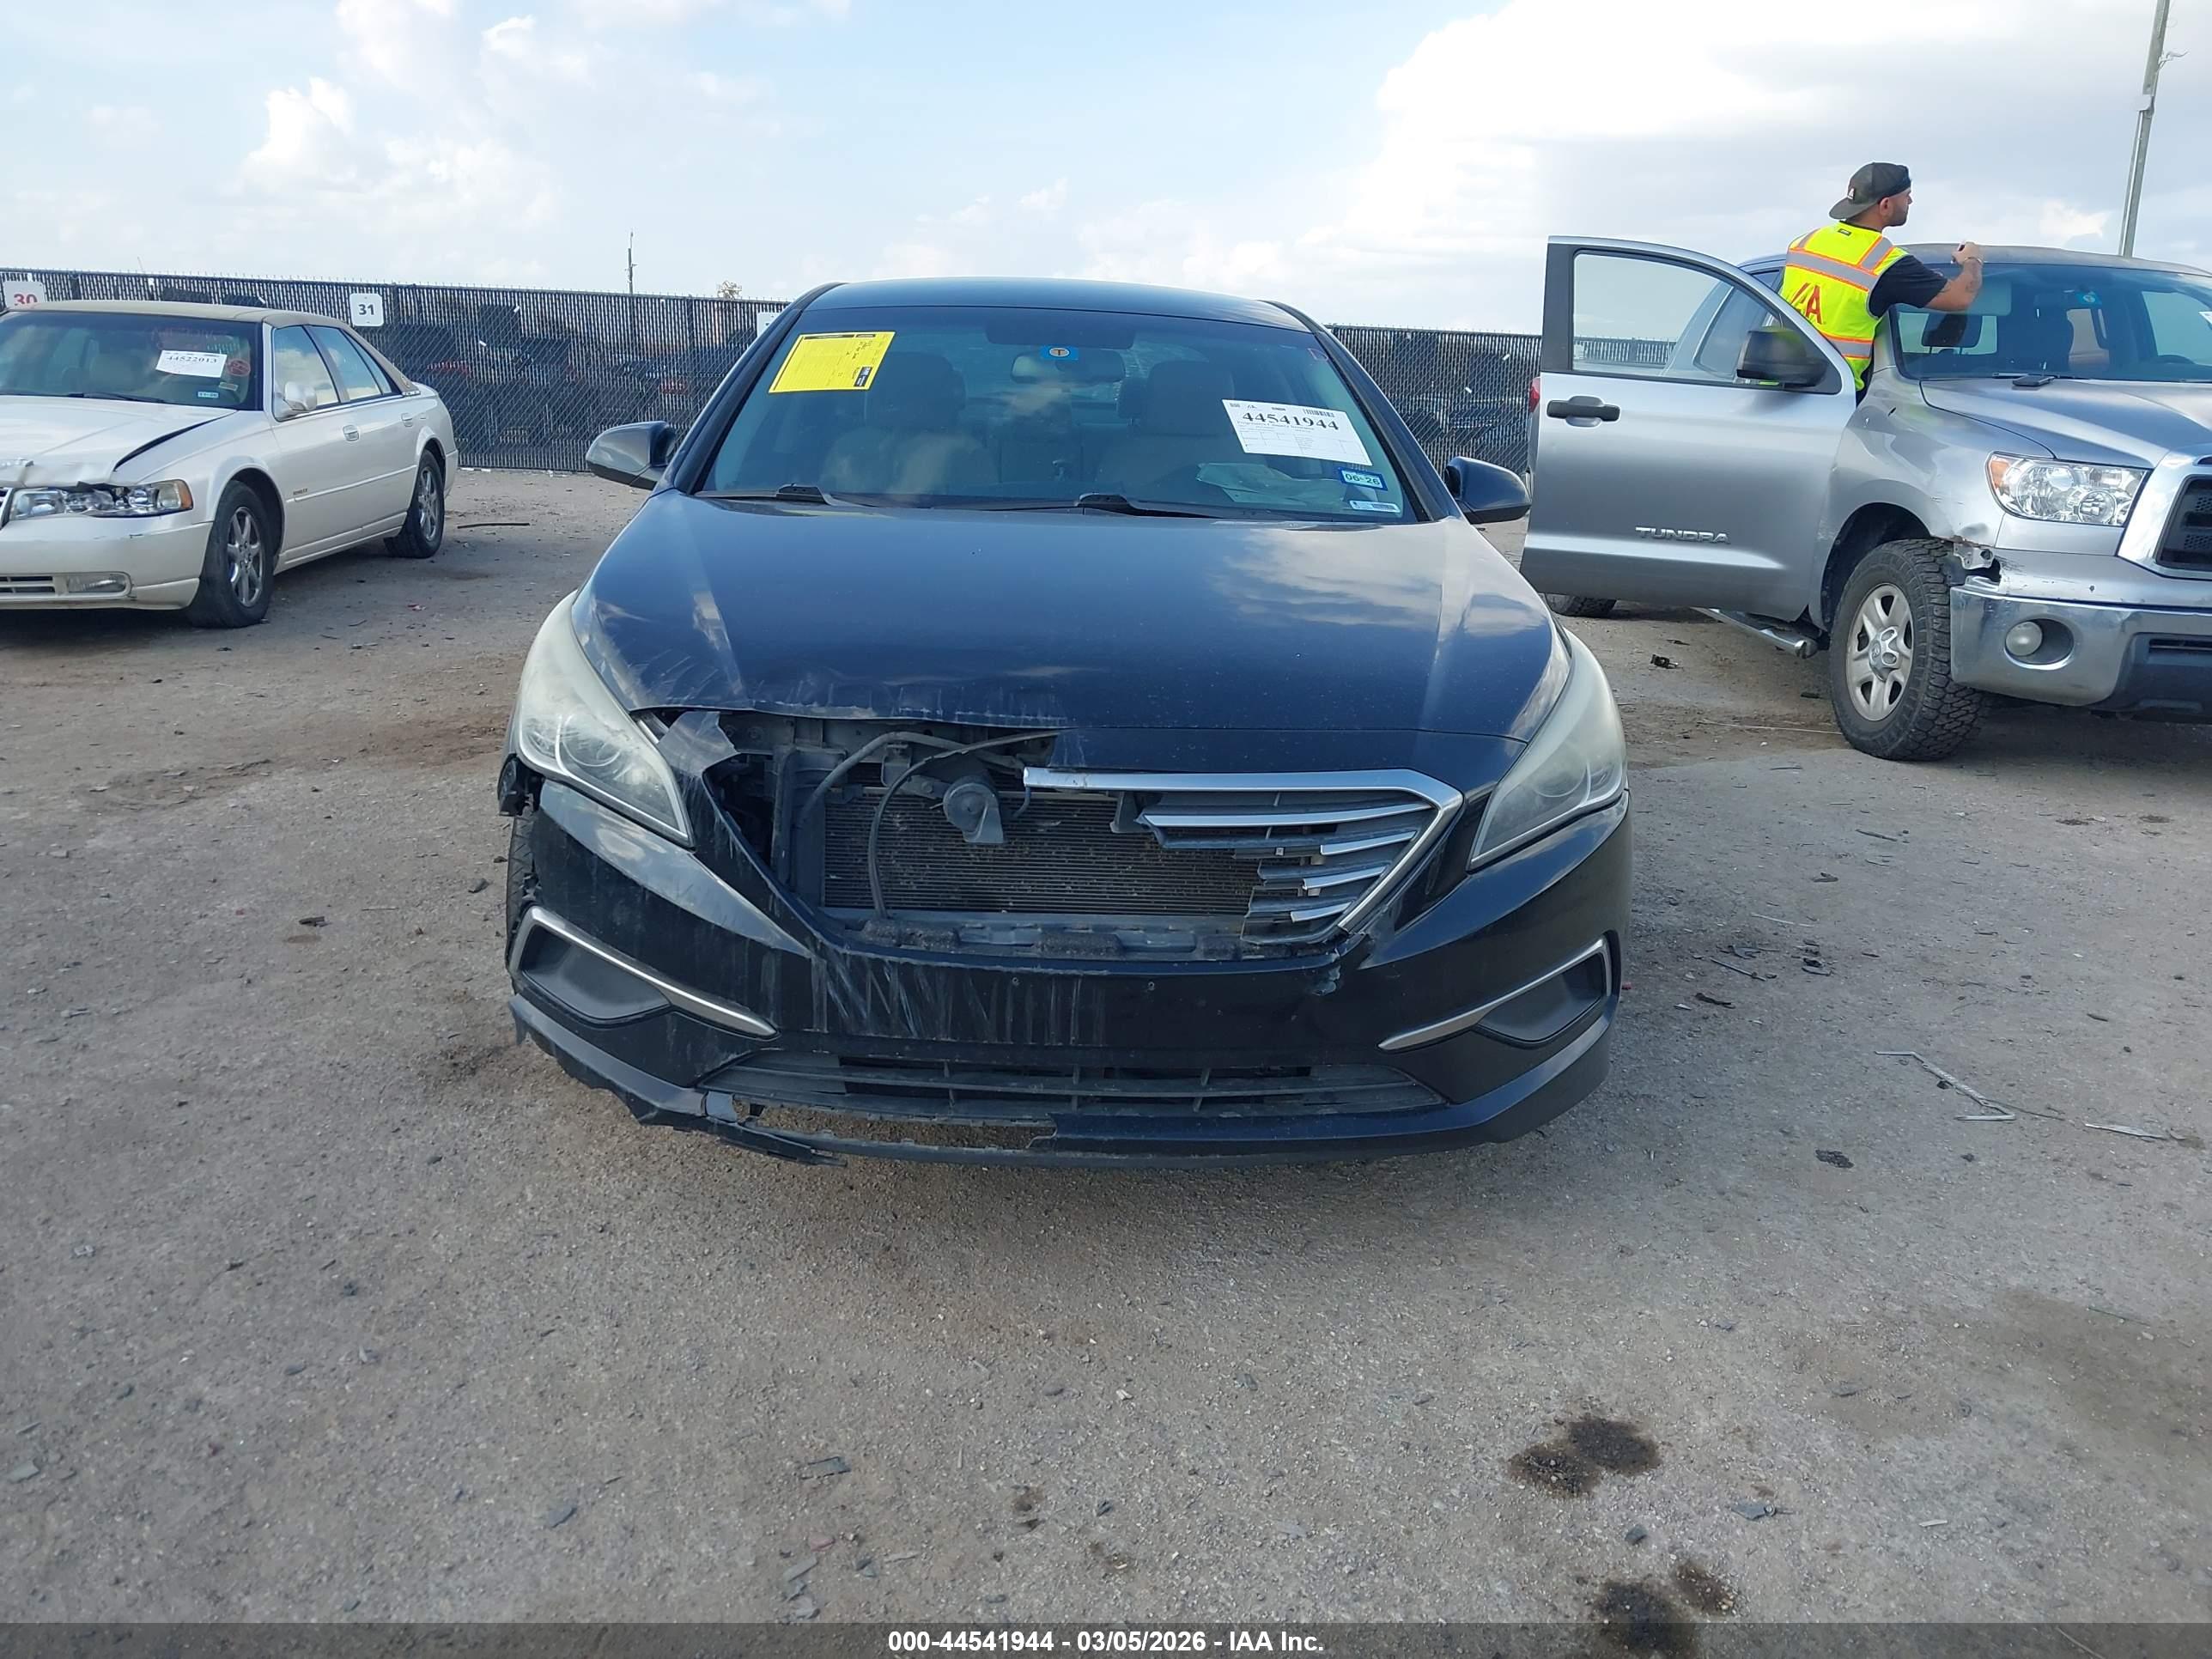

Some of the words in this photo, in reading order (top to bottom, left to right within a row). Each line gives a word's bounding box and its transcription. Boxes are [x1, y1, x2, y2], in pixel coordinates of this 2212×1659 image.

[14, 293, 38, 307] 30
[358, 303, 374, 315] 31
[1243, 411, 1340, 430] 44541944
[1345, 473, 1380, 485] 06-26
[1635, 526, 1731, 544] TUNDRA
